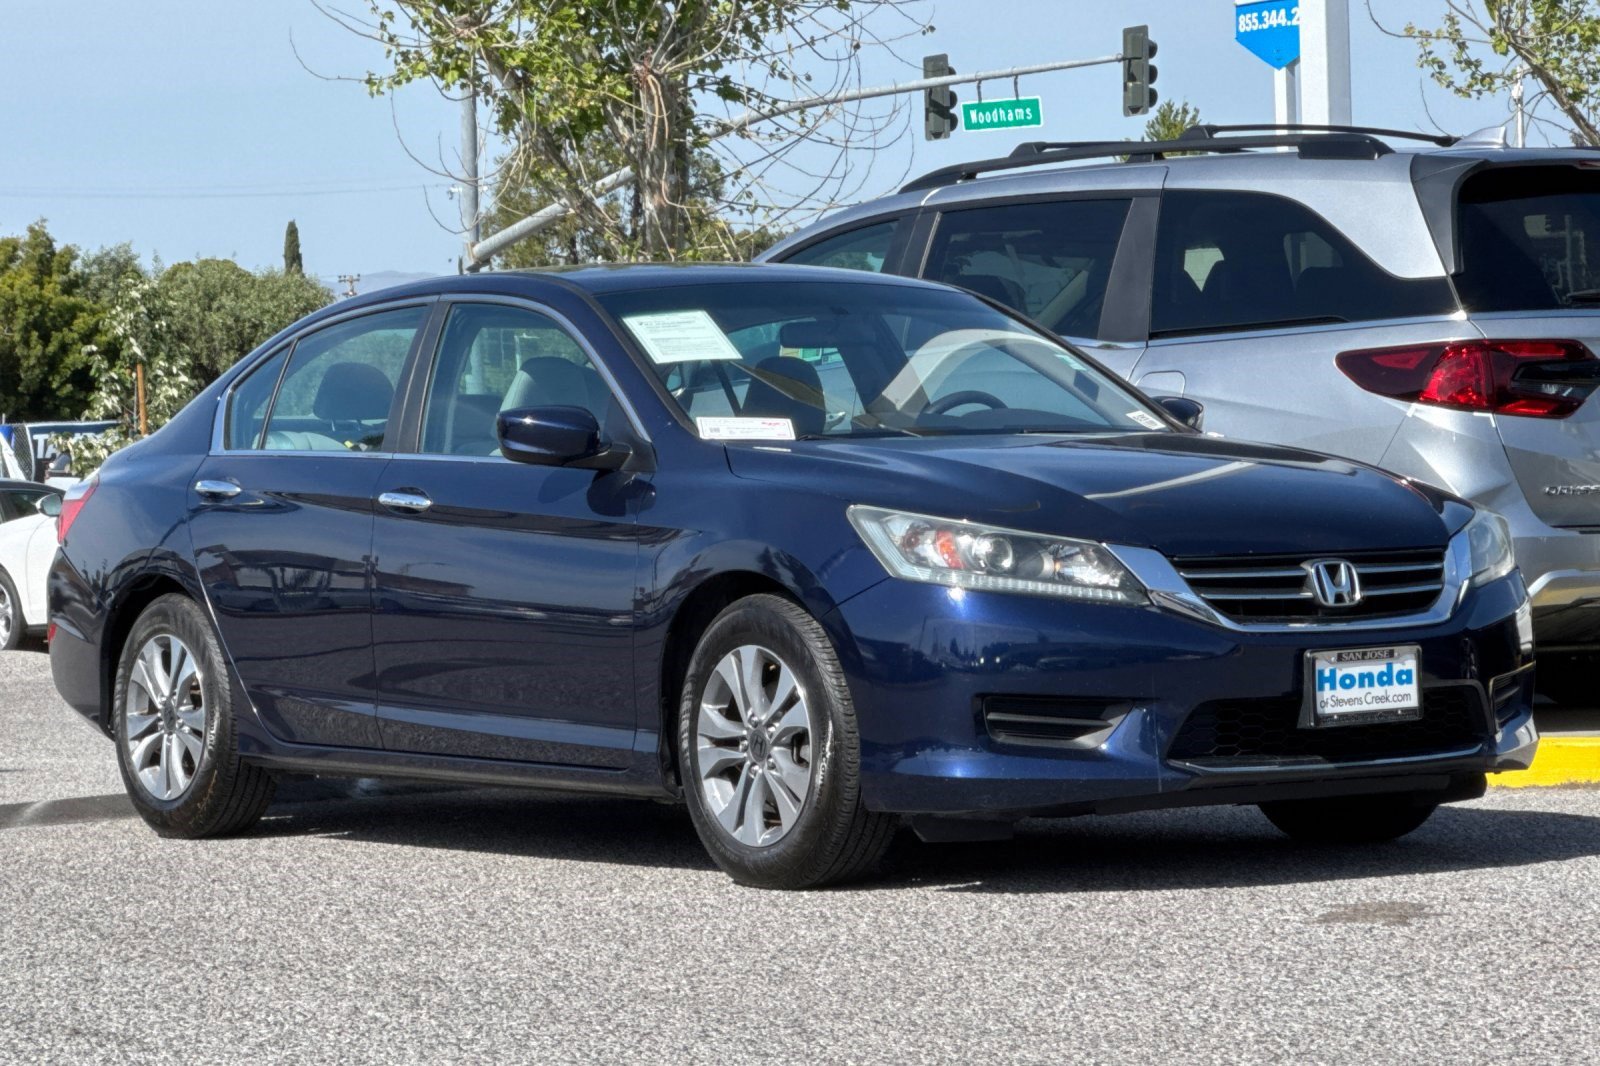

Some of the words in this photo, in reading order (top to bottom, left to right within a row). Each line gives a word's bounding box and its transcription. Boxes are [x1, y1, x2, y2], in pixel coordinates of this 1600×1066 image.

[969, 107, 1033, 124] Woodhams
[1341, 652, 1362, 661] SAN
[1364, 649, 1390, 660] JOSE
[1317, 662, 1413, 692] Honda
[1320, 698, 1329, 709] of
[1330, 695, 1363, 708] Stevens
